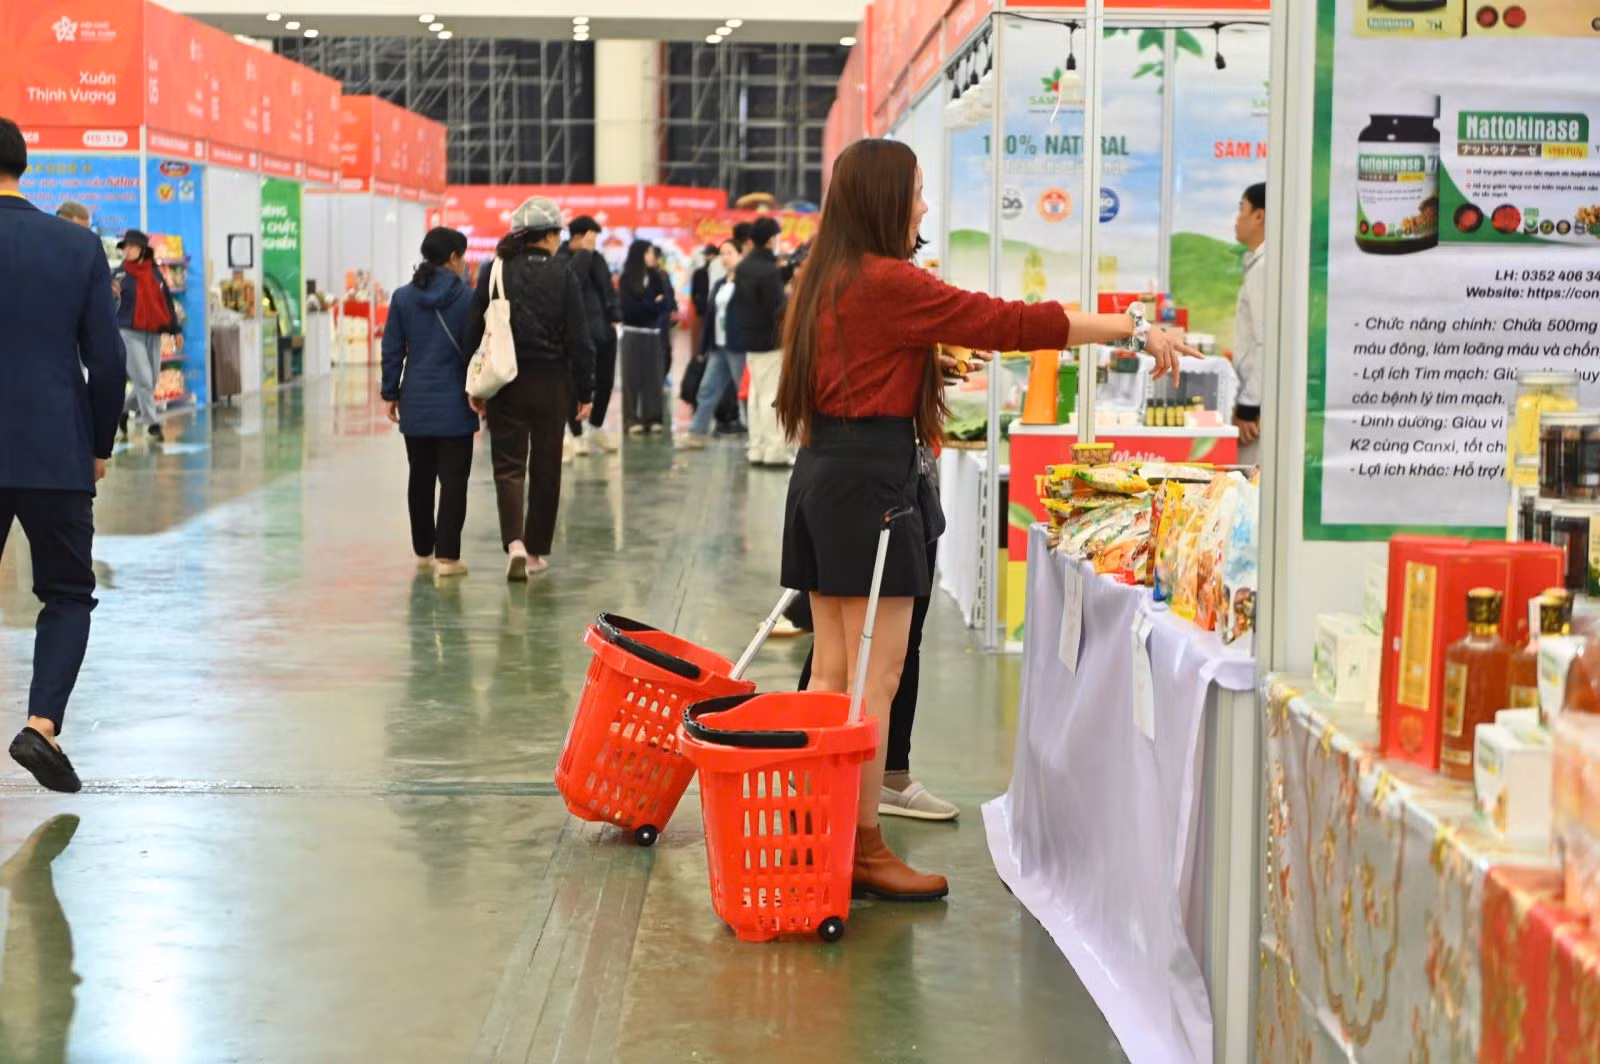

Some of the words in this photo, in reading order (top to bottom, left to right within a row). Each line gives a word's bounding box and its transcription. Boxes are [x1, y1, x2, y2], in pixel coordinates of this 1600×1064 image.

[80, 71, 116, 84] Xuân
[27, 87, 67, 103] Thịnh
[70, 88, 116, 105] Vượng
[1467, 115, 1580, 140] Nattokinase
[983, 134, 1037, 155] 10%
[1045, 134, 1129, 156] NATRAL
[1495, 269, 1518, 281] LH:
[1521, 270, 1555, 282] 0352
[1558, 270, 1582, 282] 406
[1466, 286, 1524, 299] Website:
[1365, 316, 1404, 331] Chức
[1410, 317, 1446, 333] năng
[1452, 317, 1496, 332] chính:
[1503, 317, 1541, 332] Chứa
[1547, 318, 1598, 334] 500mg
[1353, 342, 1386, 355] máu
[1389, 342, 1429, 358] đông,
[1433, 342, 1460, 355] làm
[1463, 342, 1503, 358] loãng
[1507, 342, 1539, 356] máu
[1543, 342, 1560, 356] và
[1362, 367, 1385, 383] Lợi
[1388, 366, 1410, 380] ích
[1415, 366, 1441, 380] Tim
[1444, 367, 1489, 383] mạch:
[1351, 391, 1378, 405] các
[1381, 391, 1417, 407] bệnh
[1420, 391, 1434, 407] lý
[1436, 391, 1459, 405] tim
[1461, 392, 1505, 407] mạch.
[1361, 414, 1395, 428] Dinh
[1397, 415, 1449, 431] dưỡng:
[1452, 415, 1487, 429] Giàu
[1350, 438, 1371, 451] K2
[1373, 438, 1410, 455] cùng
[1413, 439, 1459, 455] Canxi,
[1464, 436, 1483, 451] tốt
[1358, 463, 1381, 479] Lợi
[1384, 463, 1406, 476] ích
[1409, 463, 1450, 477] khác:
[1453, 461, 1475, 478] Hỗ
[1477, 464, 1499, 481] trợ
